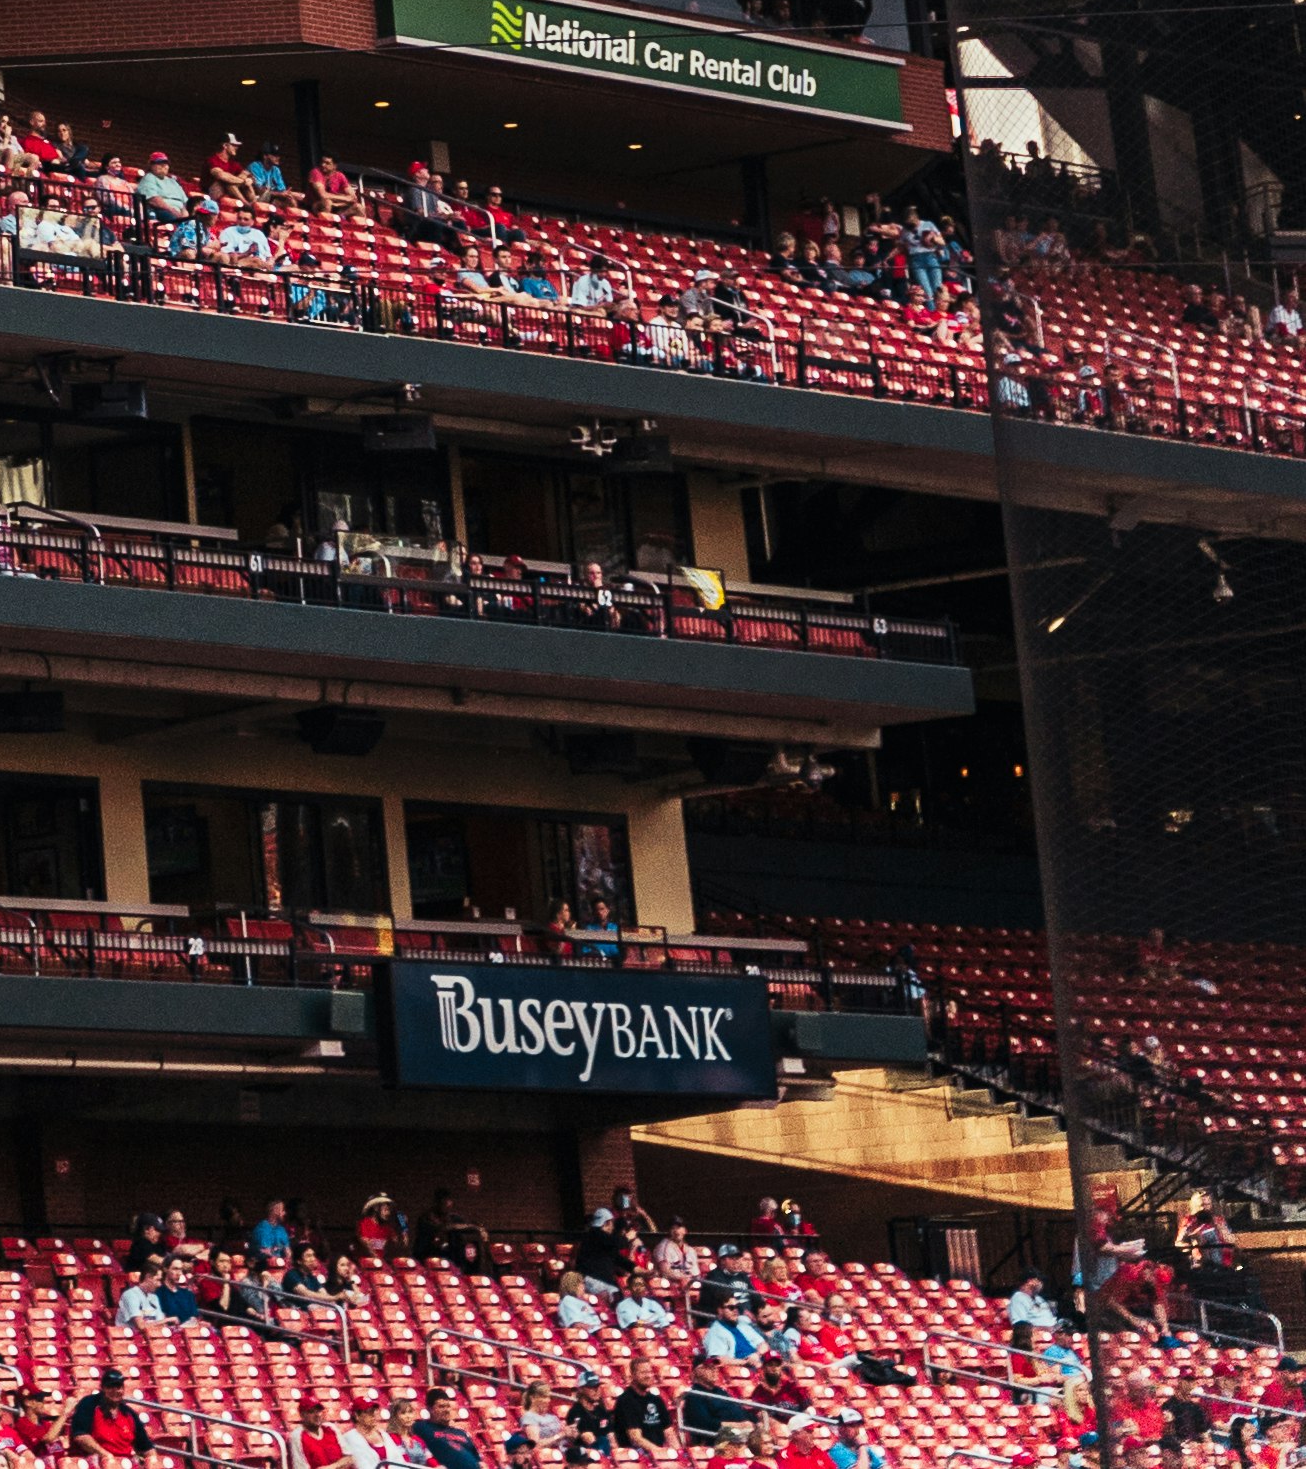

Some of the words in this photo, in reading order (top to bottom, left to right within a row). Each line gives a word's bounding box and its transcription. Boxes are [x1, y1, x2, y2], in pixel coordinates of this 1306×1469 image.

[524, 11, 636, 66] National
[644, 41, 685, 73] Car
[690, 49, 761, 88] Rental
[767, 63, 817, 97] Club
[250, 554, 263, 573] 61
[597, 588, 613, 607] 62
[872, 618, 888, 635] 63
[188, 937, 204, 956] 28
